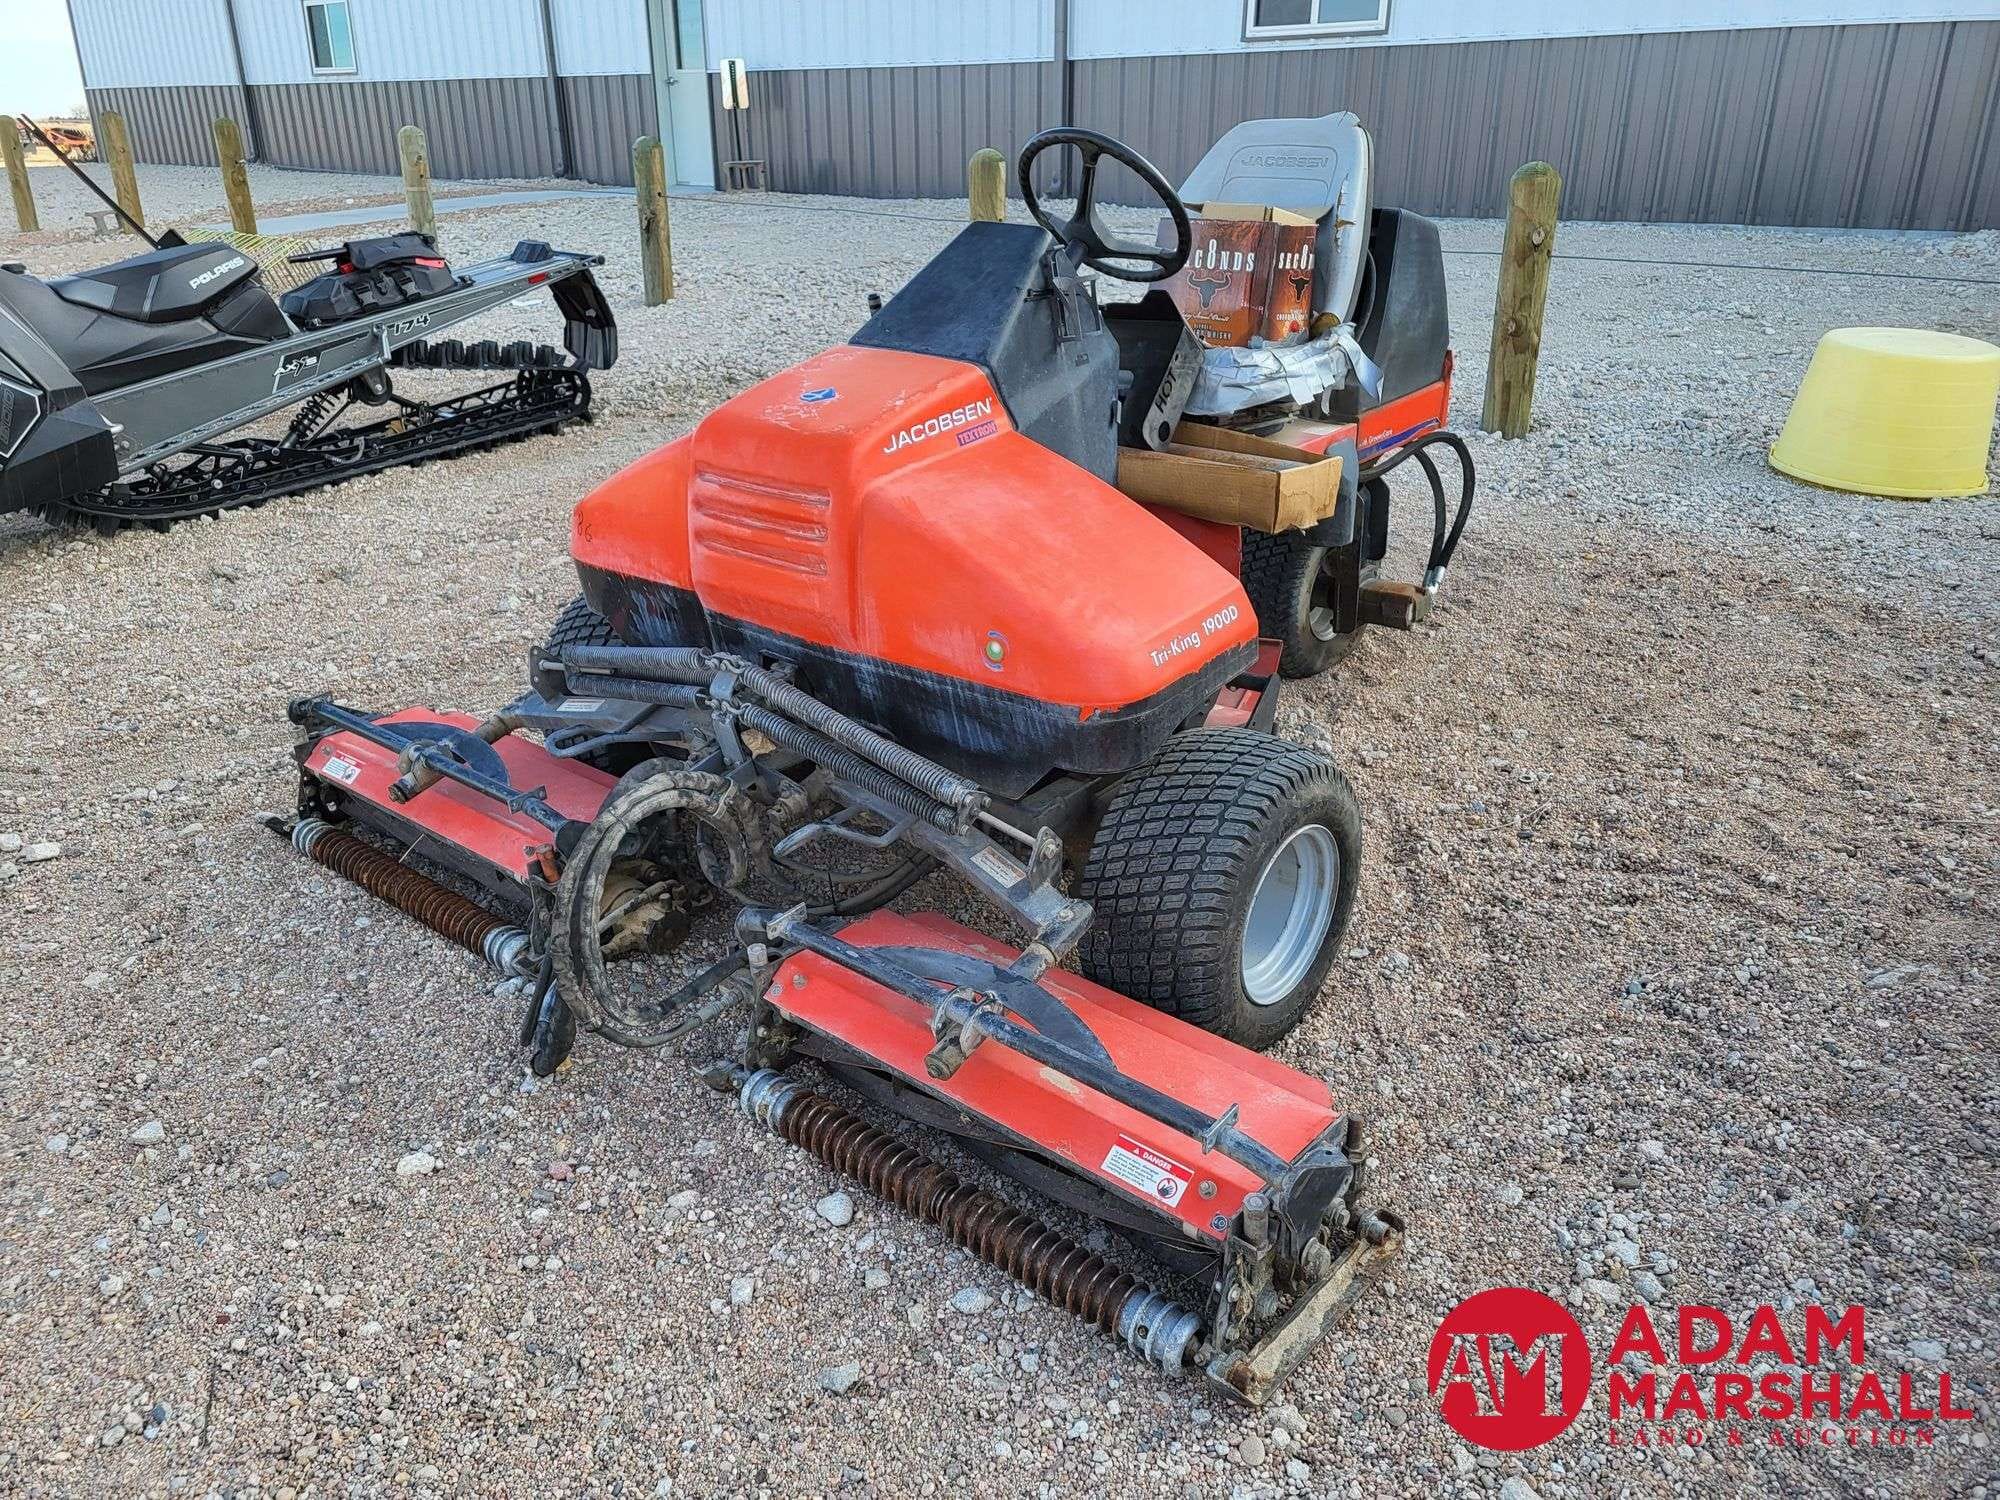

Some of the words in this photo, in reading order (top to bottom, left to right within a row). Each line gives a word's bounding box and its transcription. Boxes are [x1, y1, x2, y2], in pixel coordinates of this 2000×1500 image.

[1241, 155, 1329, 169] JACOBSEN
[188, 256, 245, 290] POLARIS
[386, 313, 431, 336] 174
[1154, 366, 1177, 414] HOT
[883, 397, 993, 454] JACOBSEN
[957, 421, 999, 446] TEXTRON
[1150, 632, 1201, 667] Tri-King
[1201, 605, 1239, 636] 1900D
[1142, 1151, 1173, 1172] DANGER
